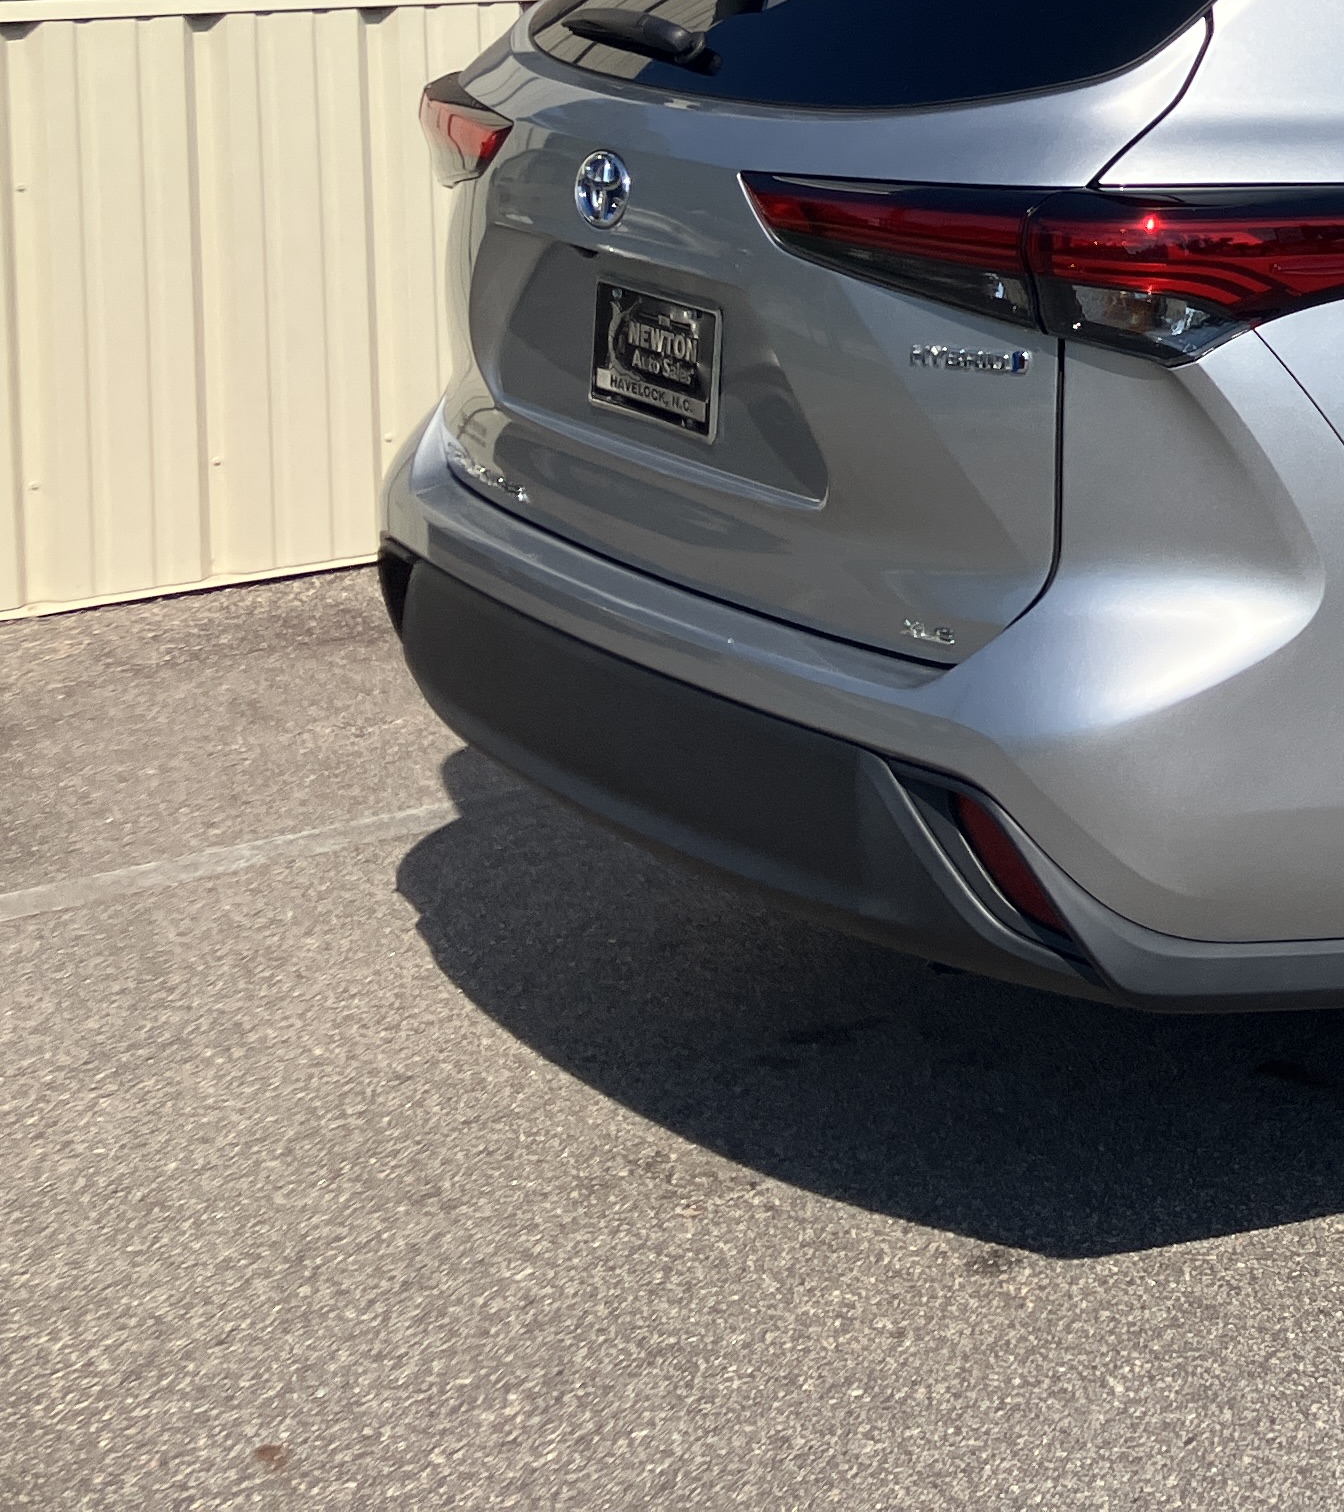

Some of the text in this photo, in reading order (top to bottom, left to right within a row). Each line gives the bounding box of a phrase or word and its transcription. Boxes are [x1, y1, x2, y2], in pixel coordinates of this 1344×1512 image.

[628, 320, 697, 363] NEWTON
[632, 349, 694, 385] Auto Sales
[610, 373, 669, 407] HAVELOCK,
